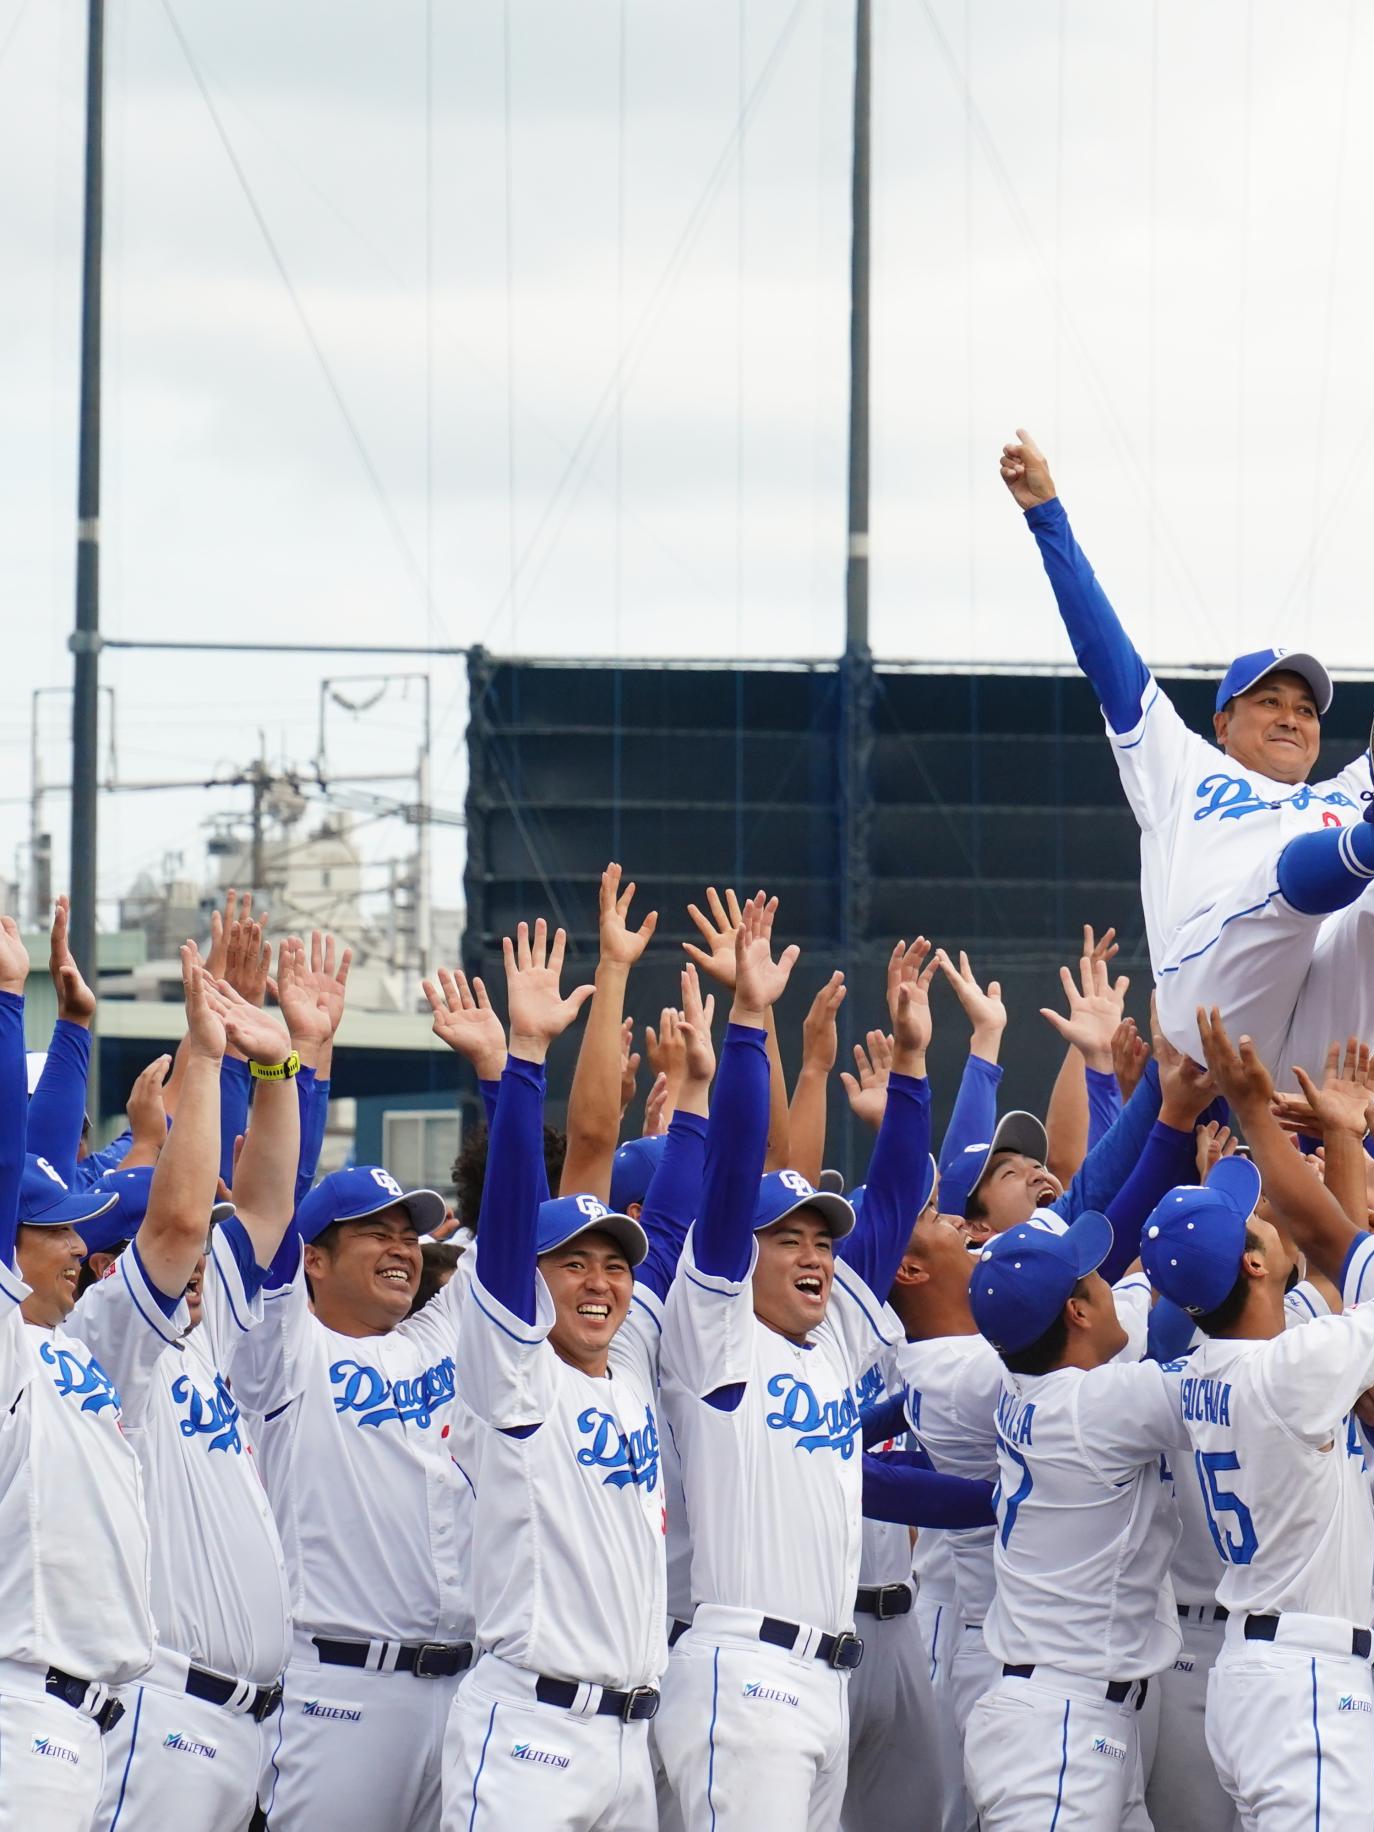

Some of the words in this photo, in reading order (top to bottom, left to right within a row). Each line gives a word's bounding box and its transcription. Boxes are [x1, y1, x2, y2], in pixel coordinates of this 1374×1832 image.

[742, 1680, 800, 1706] MEITETSU
[302, 1698, 362, 1722] MEITETSU
[163, 1731, 217, 1760] MEITETSU
[511, 1742, 571, 1769] MEITETSU
